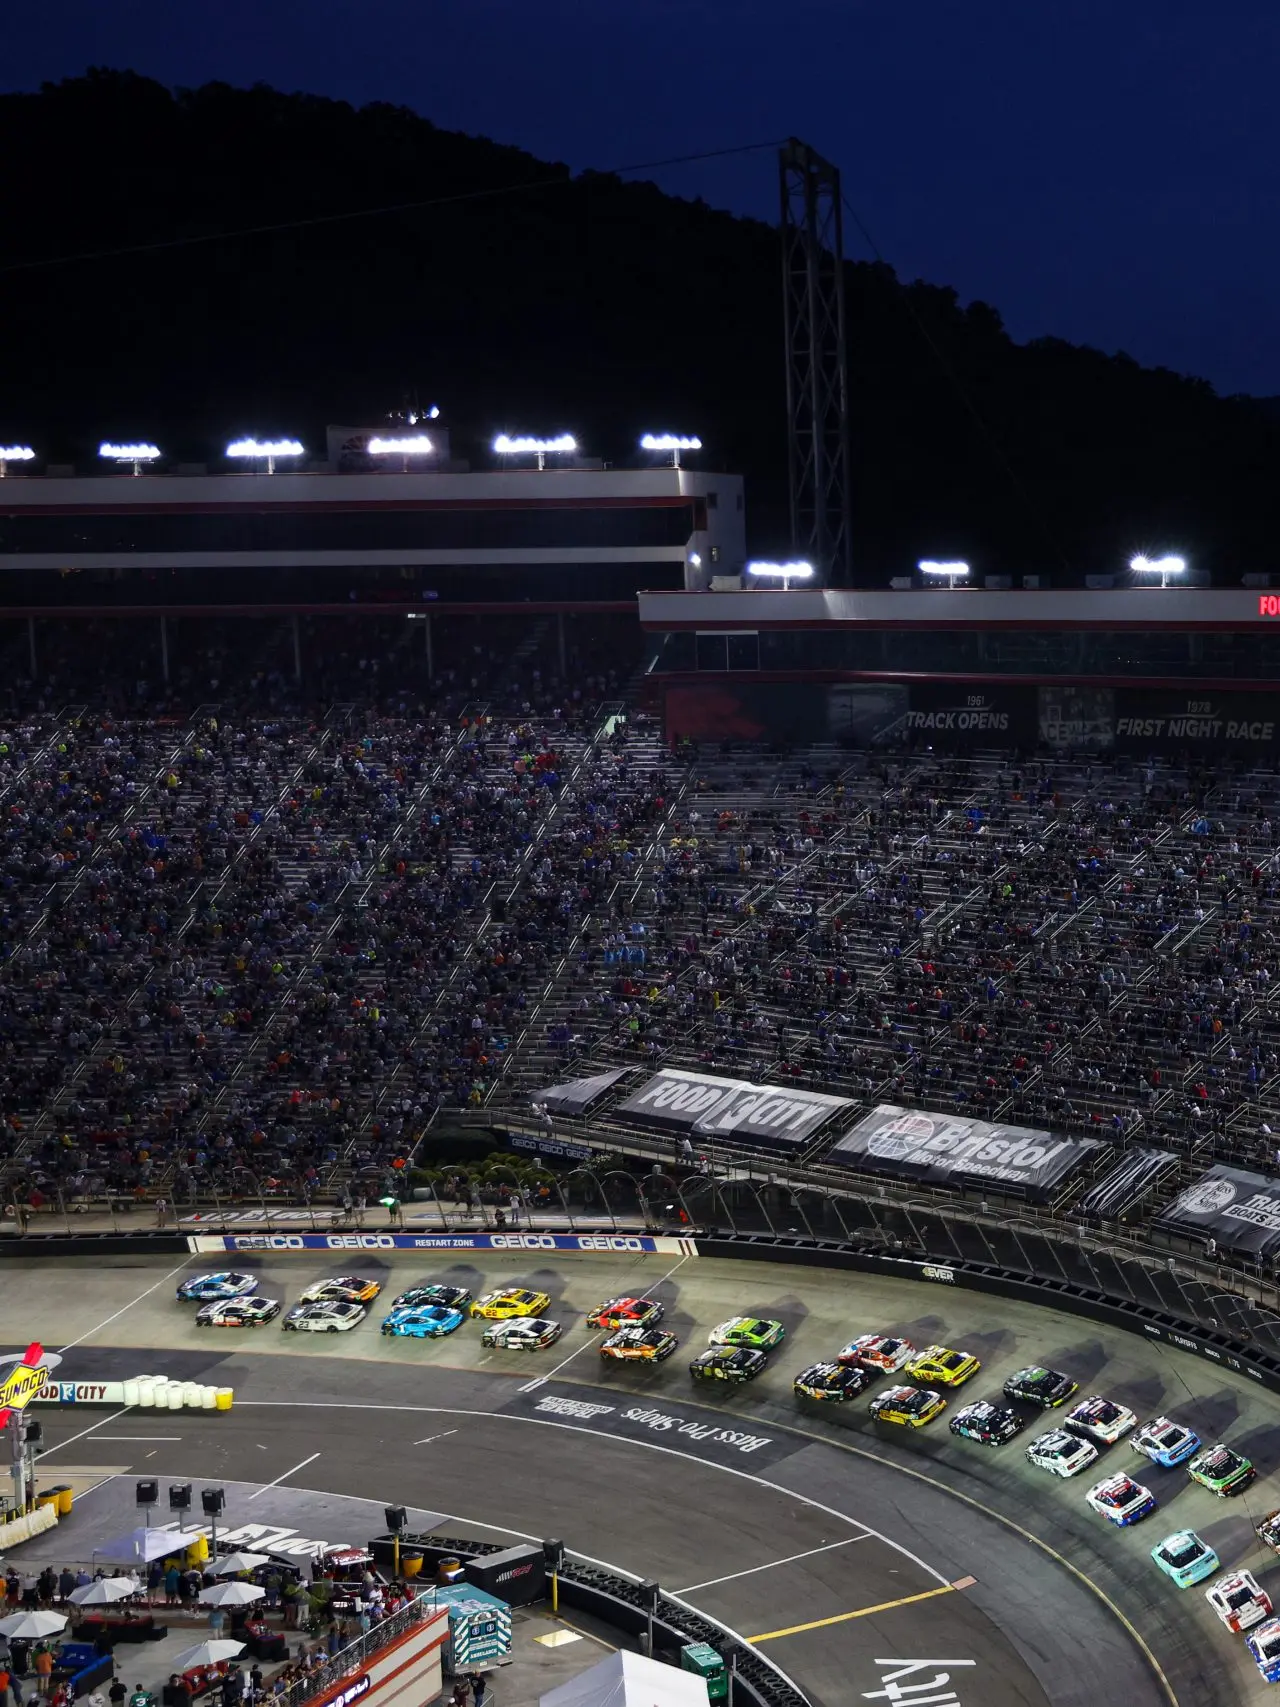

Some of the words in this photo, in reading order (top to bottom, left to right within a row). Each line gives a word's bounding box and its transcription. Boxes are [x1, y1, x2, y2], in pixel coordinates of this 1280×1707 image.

[966, 695, 985, 706] 1961
[1186, 700, 1211, 714] 1978
[906, 710, 956, 730] TRACK
[957, 712, 1009, 731] OPENS
[1116, 717, 1164, 738] FIRST
[1167, 719, 1224, 740] NIGHT
[1226, 721, 1275, 742] RACE
[638, 1081, 724, 1113] FOOD
[749, 1101, 828, 1131] CITY
[511, 1137, 537, 1150] GEICO
[539, 1141, 564, 1155] GEICO
[926, 1122, 1066, 1170] Bristol
[902, 1148, 954, 1170] Motor
[953, 1157, 1031, 1183] Speedway
[1228, 1206, 1269, 1223] BOATS
[233, 1236, 305, 1250] GEICO
[326, 1235, 397, 1249] GEICO
[414, 1238, 452, 1247] RESTART
[452, 1238, 475, 1247] ZONE
[490, 1234, 557, 1249] GEICO
[577, 1236, 644, 1251] GEICO
[485, 1308, 498, 1317] 22
[298, 1320, 310, 1329] 23
[0, 1369, 46, 1406] SUNOCO
[76, 1385, 107, 1400] CITY
[534, 1402, 601, 1419] TRACKER
[620, 1406, 685, 1432] Shops
[677, 1422, 715, 1440] Pro
[714, 1429, 774, 1453] Bass
